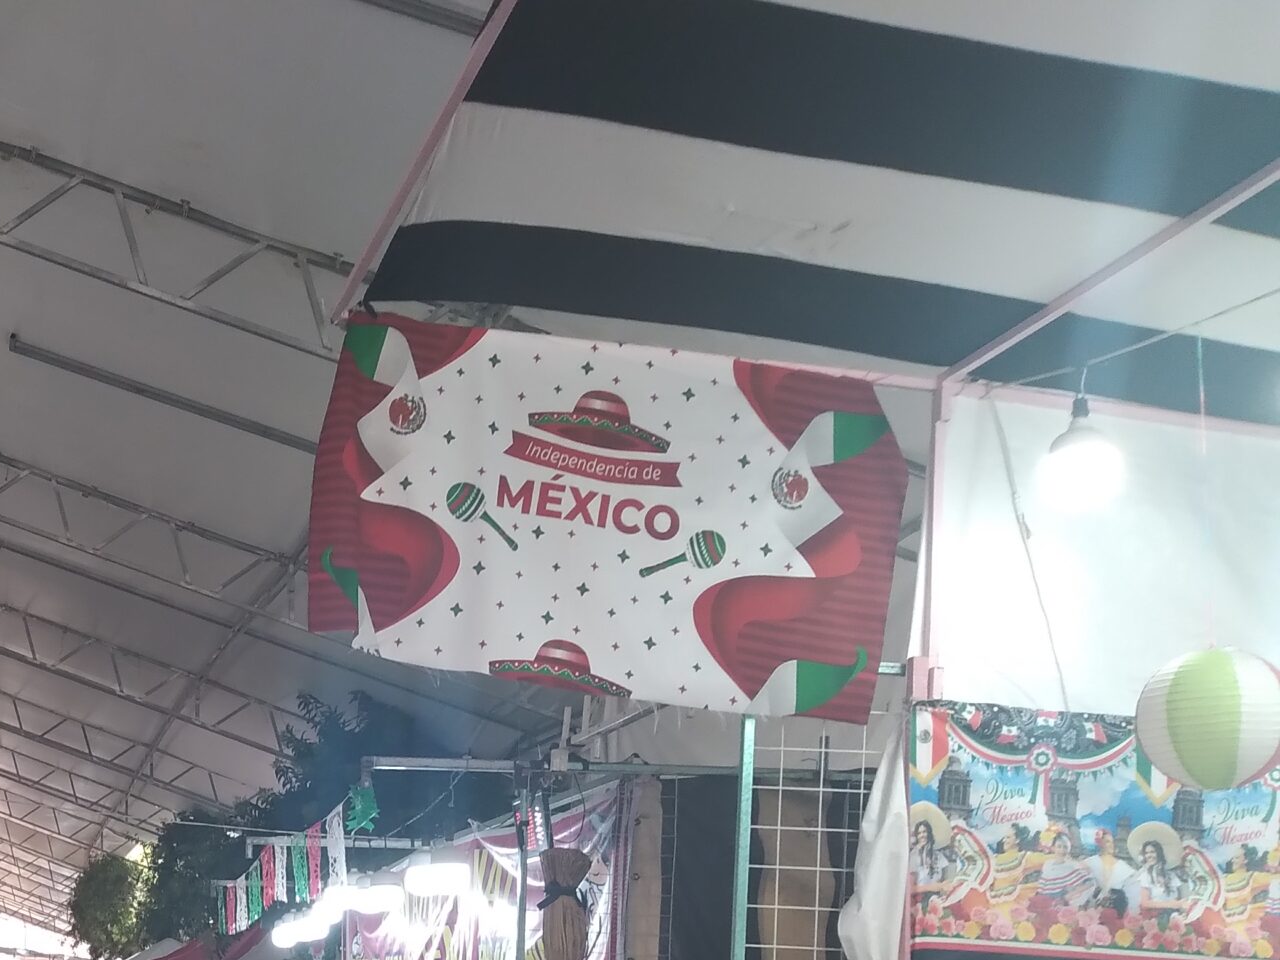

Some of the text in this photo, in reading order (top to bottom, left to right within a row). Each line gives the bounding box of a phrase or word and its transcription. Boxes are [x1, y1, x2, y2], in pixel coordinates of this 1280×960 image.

[525, 440, 662, 481] Independencia de
[496, 473, 680, 541] MÉXICO
